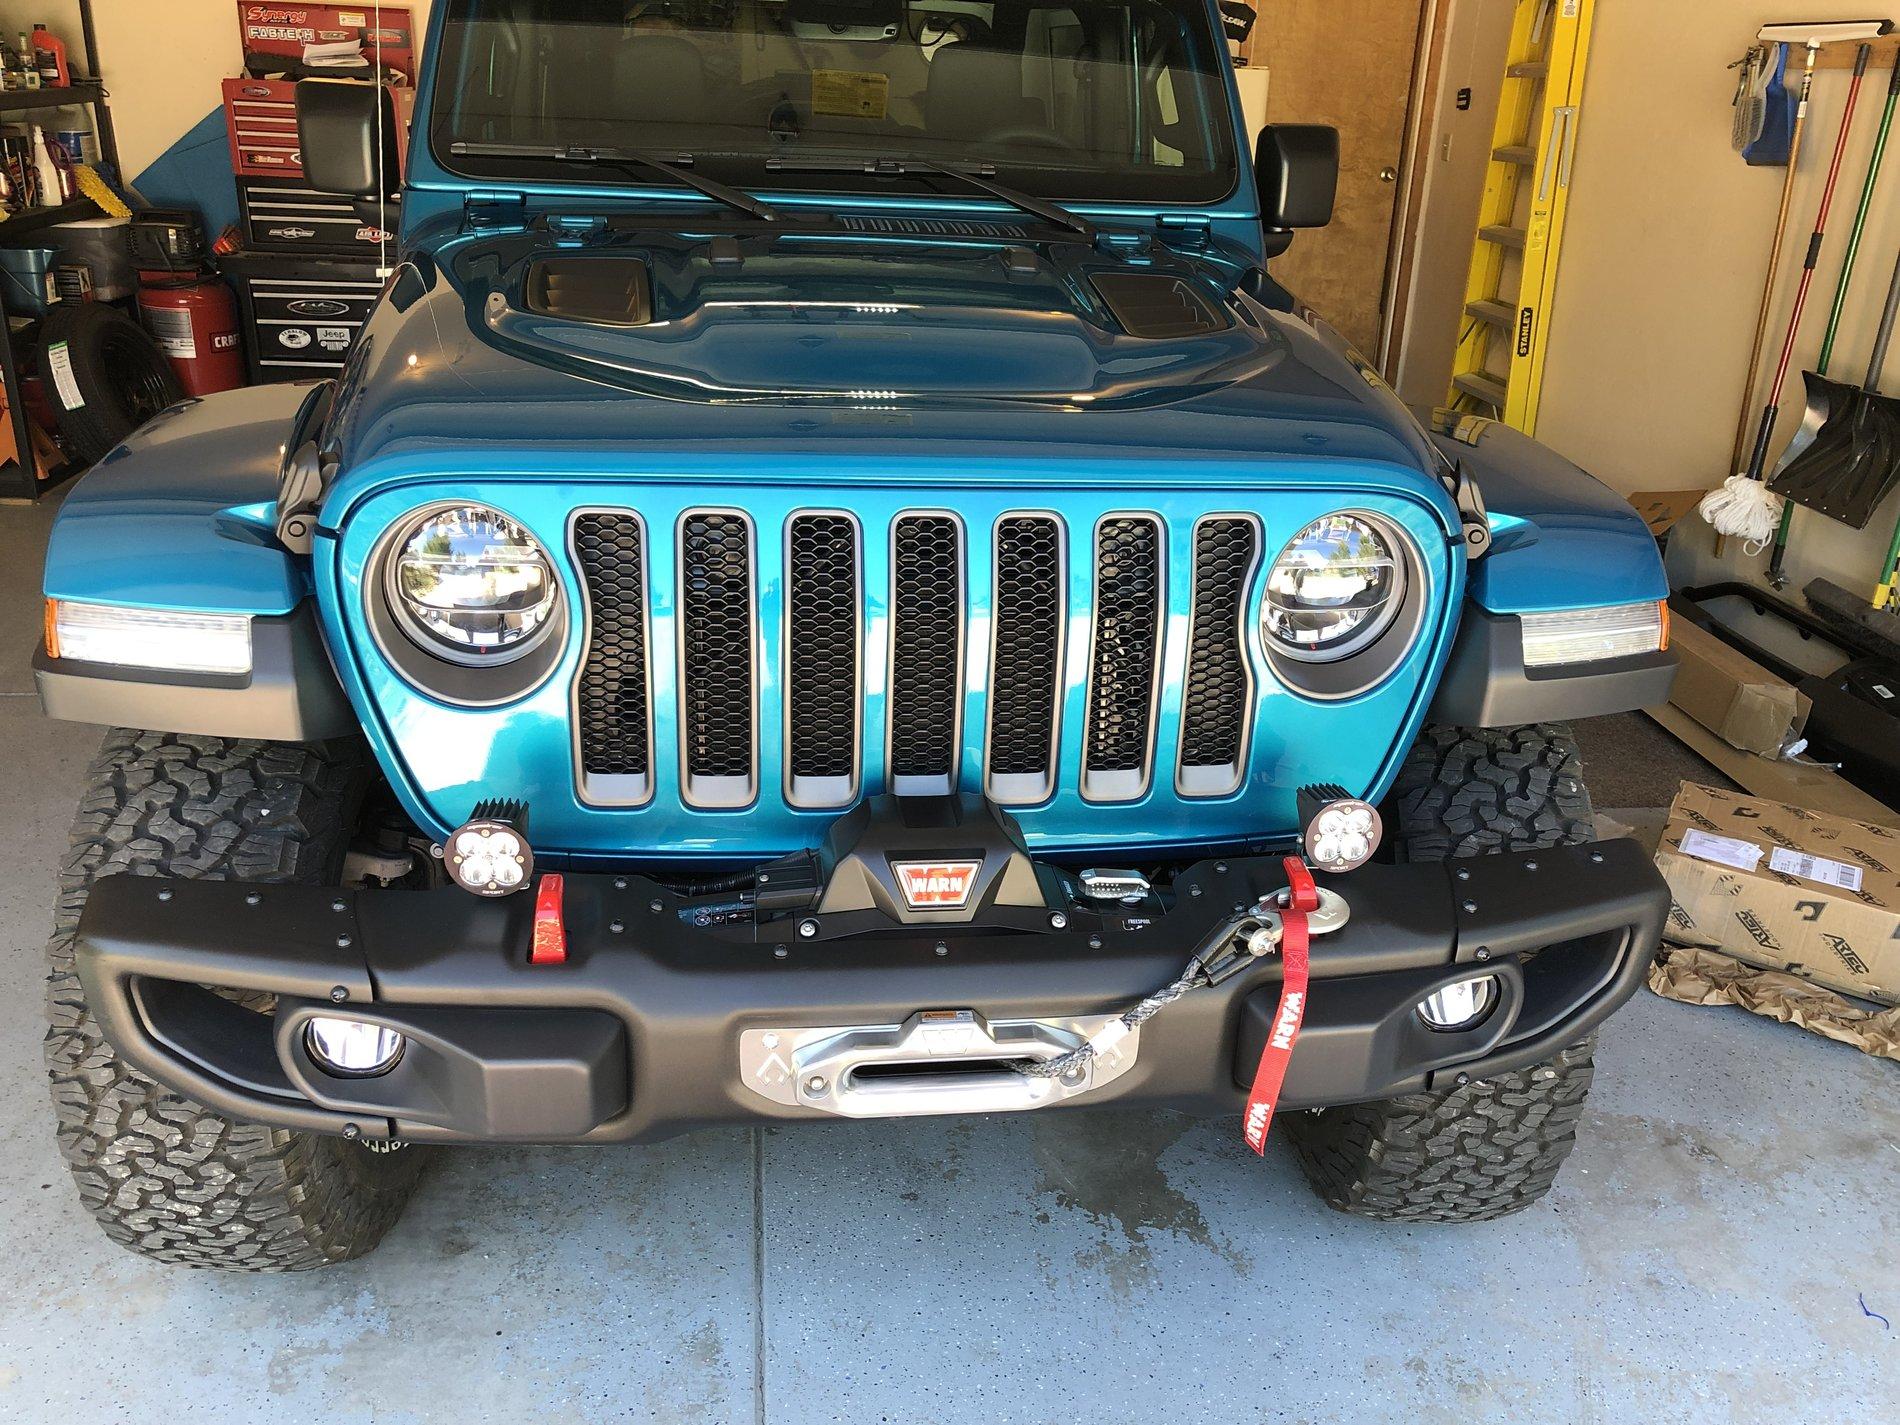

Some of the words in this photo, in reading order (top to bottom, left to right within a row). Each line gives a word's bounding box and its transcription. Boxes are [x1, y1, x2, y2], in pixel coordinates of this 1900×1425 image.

[247, 7, 307, 23] Synergy
[323, 330, 345, 339] Jeep
[1520, 311, 1531, 354] STANLEY
[912, 877, 963, 892] WARN
[1735, 910, 1780, 950] ARTEC
[1822, 933, 1869, 974] ARTEC
[1271, 992, 1303, 1050] WARN
